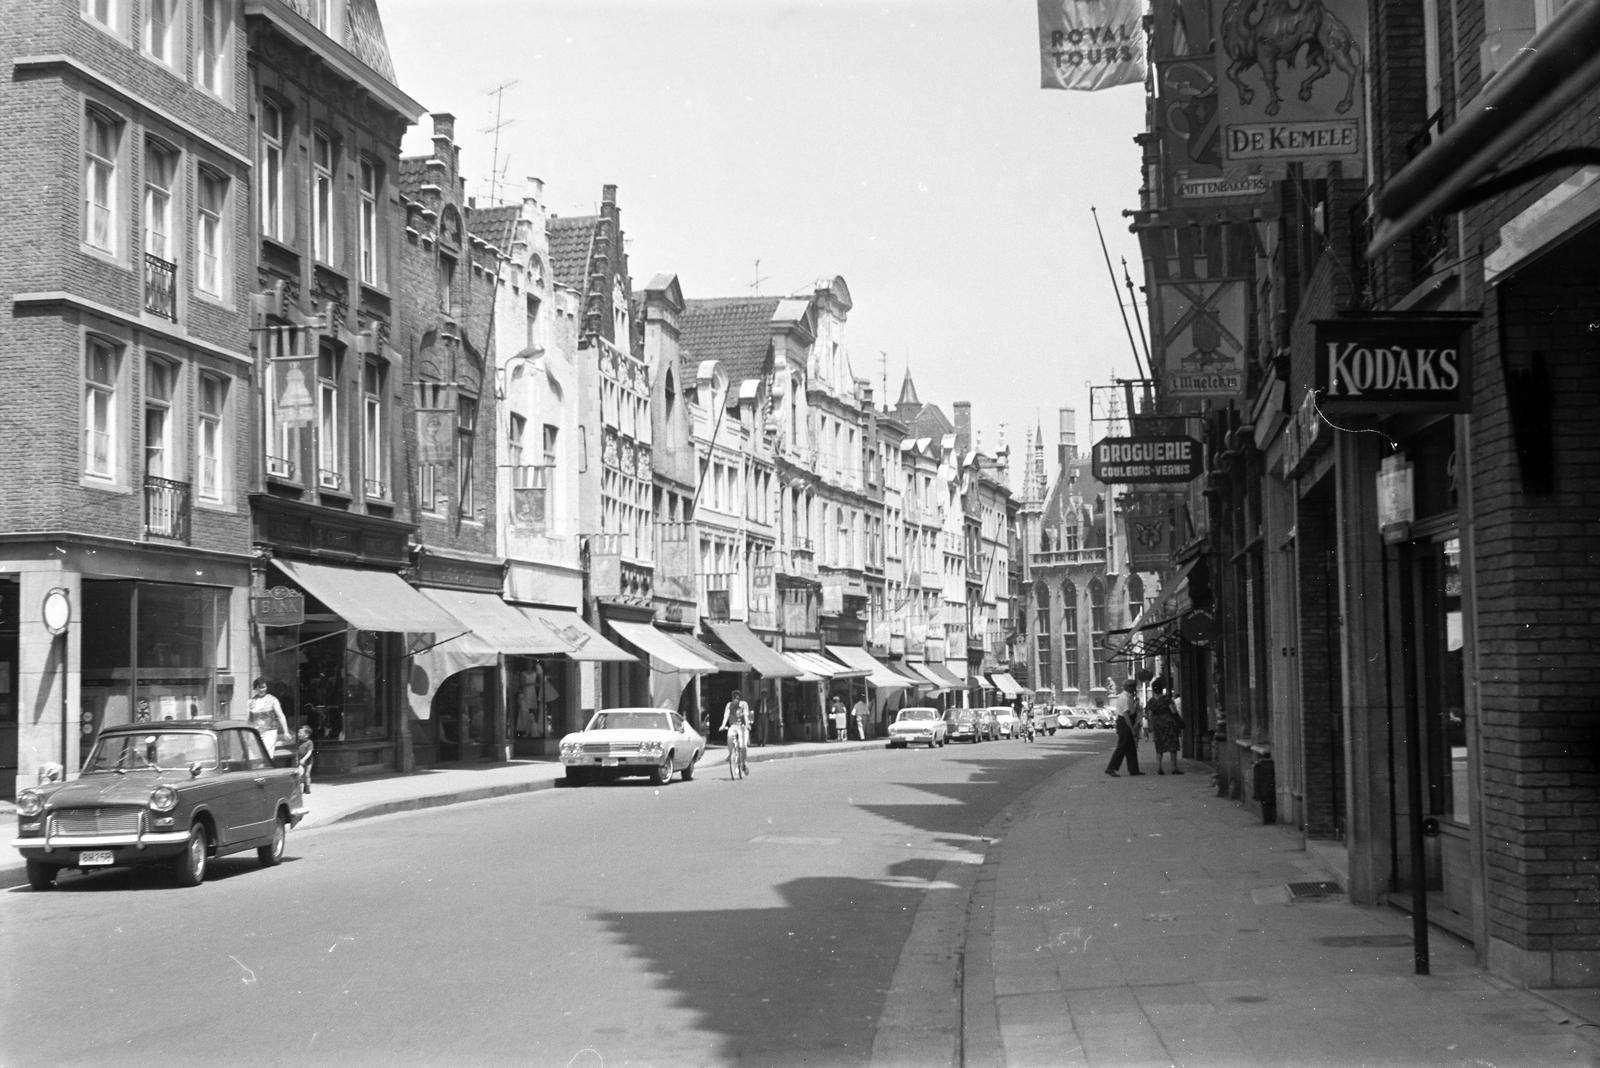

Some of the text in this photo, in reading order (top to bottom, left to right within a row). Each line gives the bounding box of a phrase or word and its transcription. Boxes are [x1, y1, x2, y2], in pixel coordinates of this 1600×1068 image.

[1051, 24, 1130, 48] ROYAL
[1051, 45, 1131, 68] TOURS
[1232, 127, 1352, 152] DE KEMELE
[1326, 341, 1459, 395] KODAKS
[1099, 440, 1192, 463] DROGUERIE
